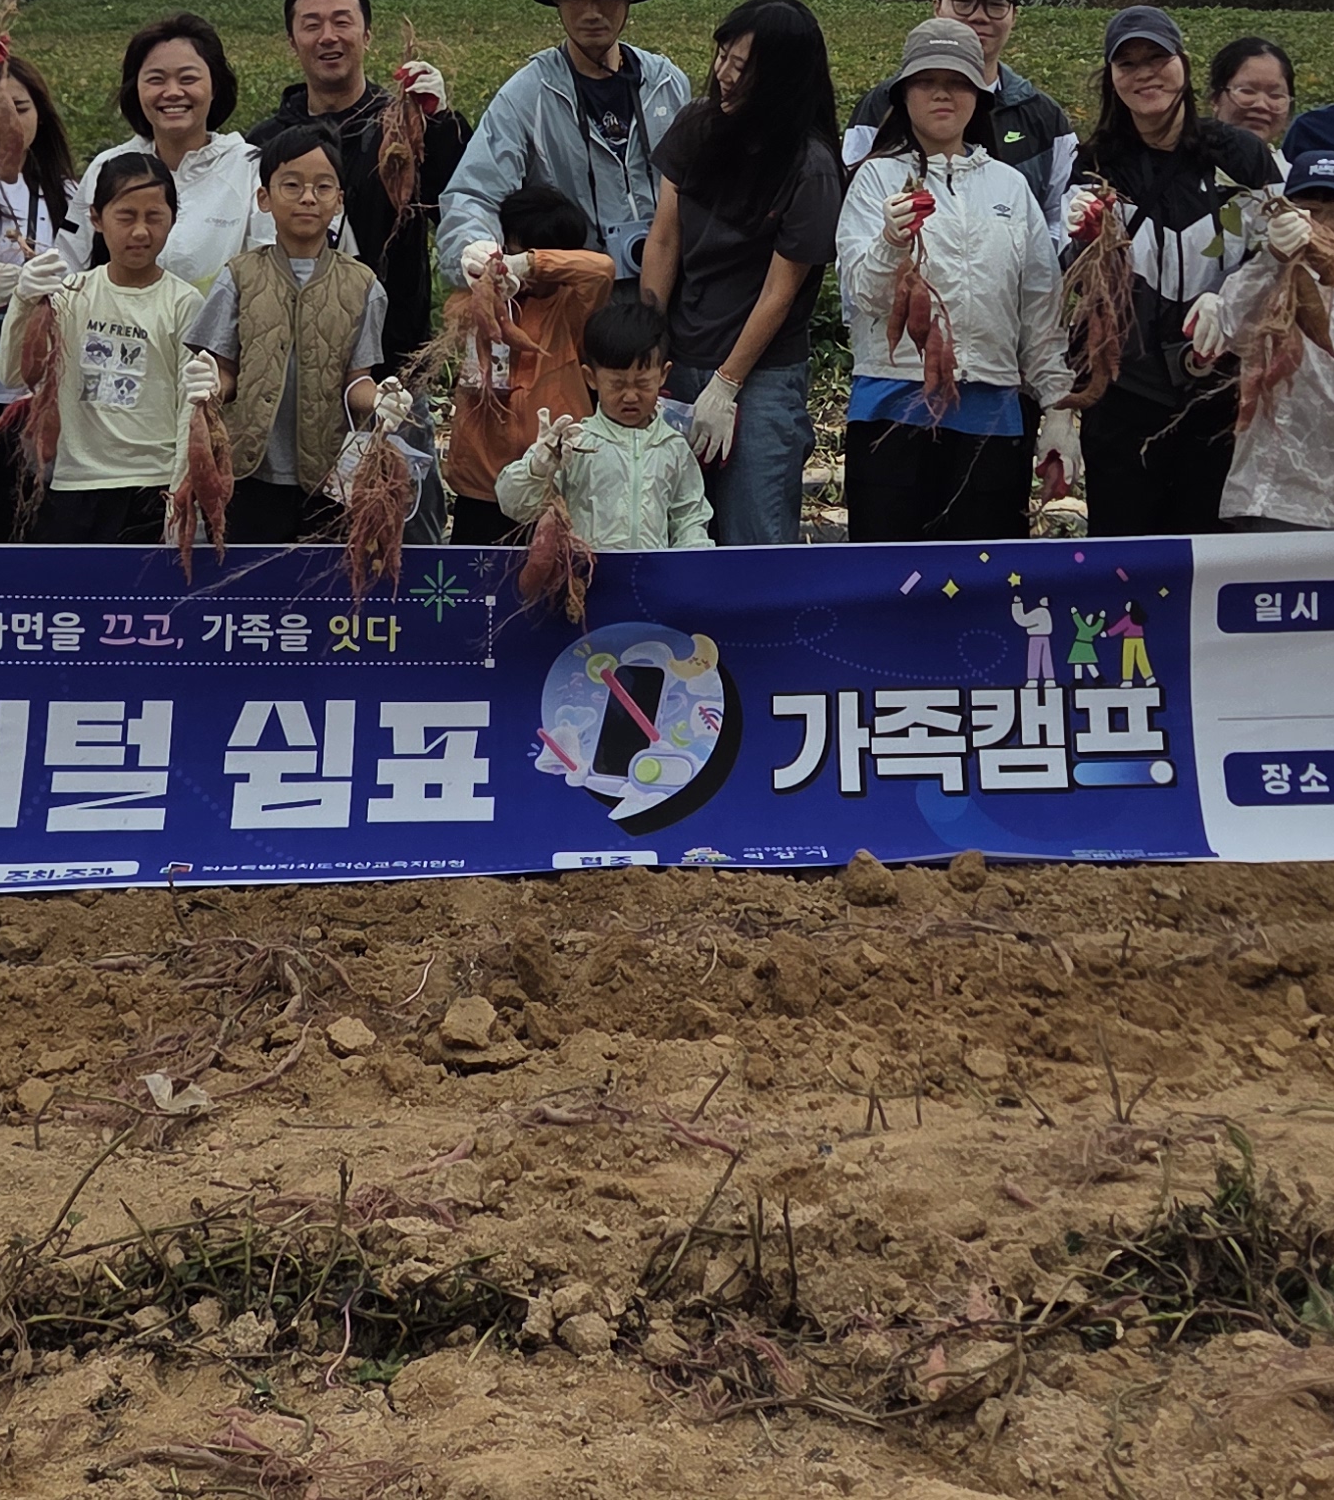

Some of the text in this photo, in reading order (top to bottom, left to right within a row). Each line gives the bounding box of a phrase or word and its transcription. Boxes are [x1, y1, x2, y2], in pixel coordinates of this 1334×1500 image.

[86, 318, 107, 333] MY
[99, 613, 184, 649] 끄고,
[201, 612, 312, 652] 가족을
[328, 613, 402, 652] 잇다
[223, 699, 495, 830] 쉼표
[772, 686, 1175, 793] 가족캠프
